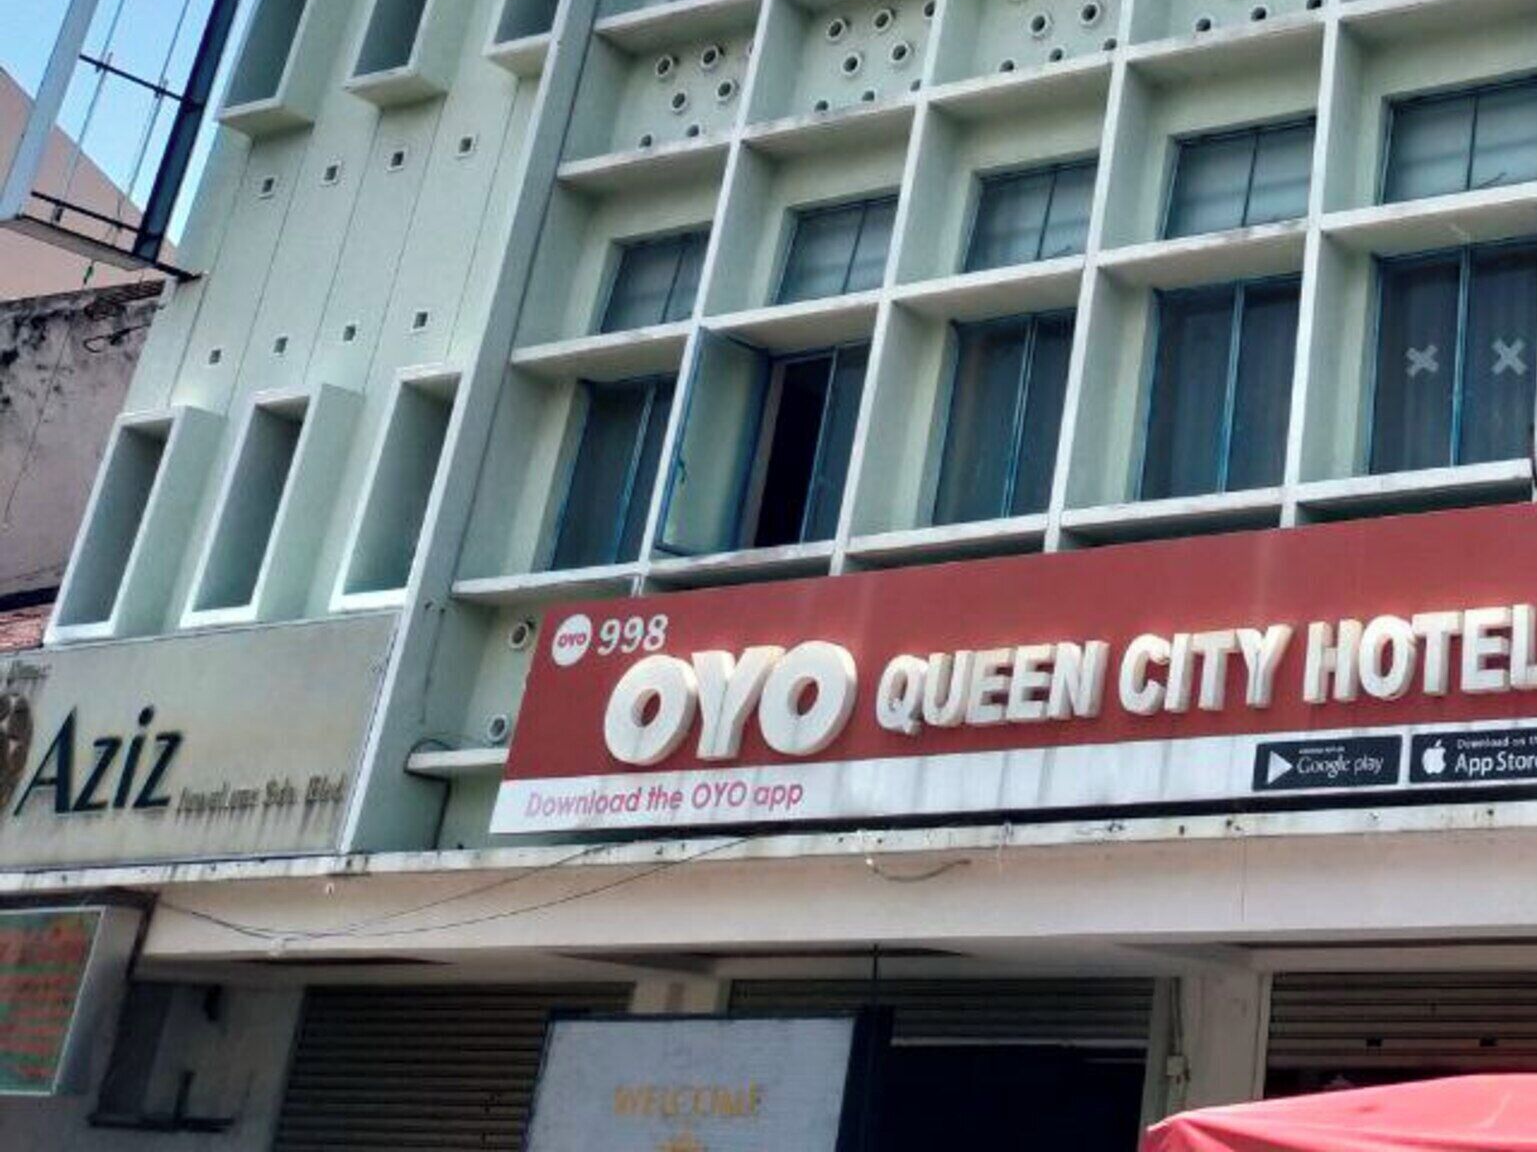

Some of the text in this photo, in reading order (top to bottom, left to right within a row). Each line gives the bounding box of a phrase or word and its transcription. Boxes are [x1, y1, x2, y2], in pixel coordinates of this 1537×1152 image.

[557, 613, 669, 656] OYO 998
[604, 640, 858, 766] OYO
[875, 640, 1109, 736] QUEEN
[1118, 623, 1294, 716] CITY
[13, 705, 185, 815] Aziz
[1456, 736, 1508, 749] Download
[1510, 738, 1526, 748] on
[1296, 755, 1384, 778] Google play
[1454, 754, 1493, 777] App
[524, 781, 804, 817] Download the OYO app
